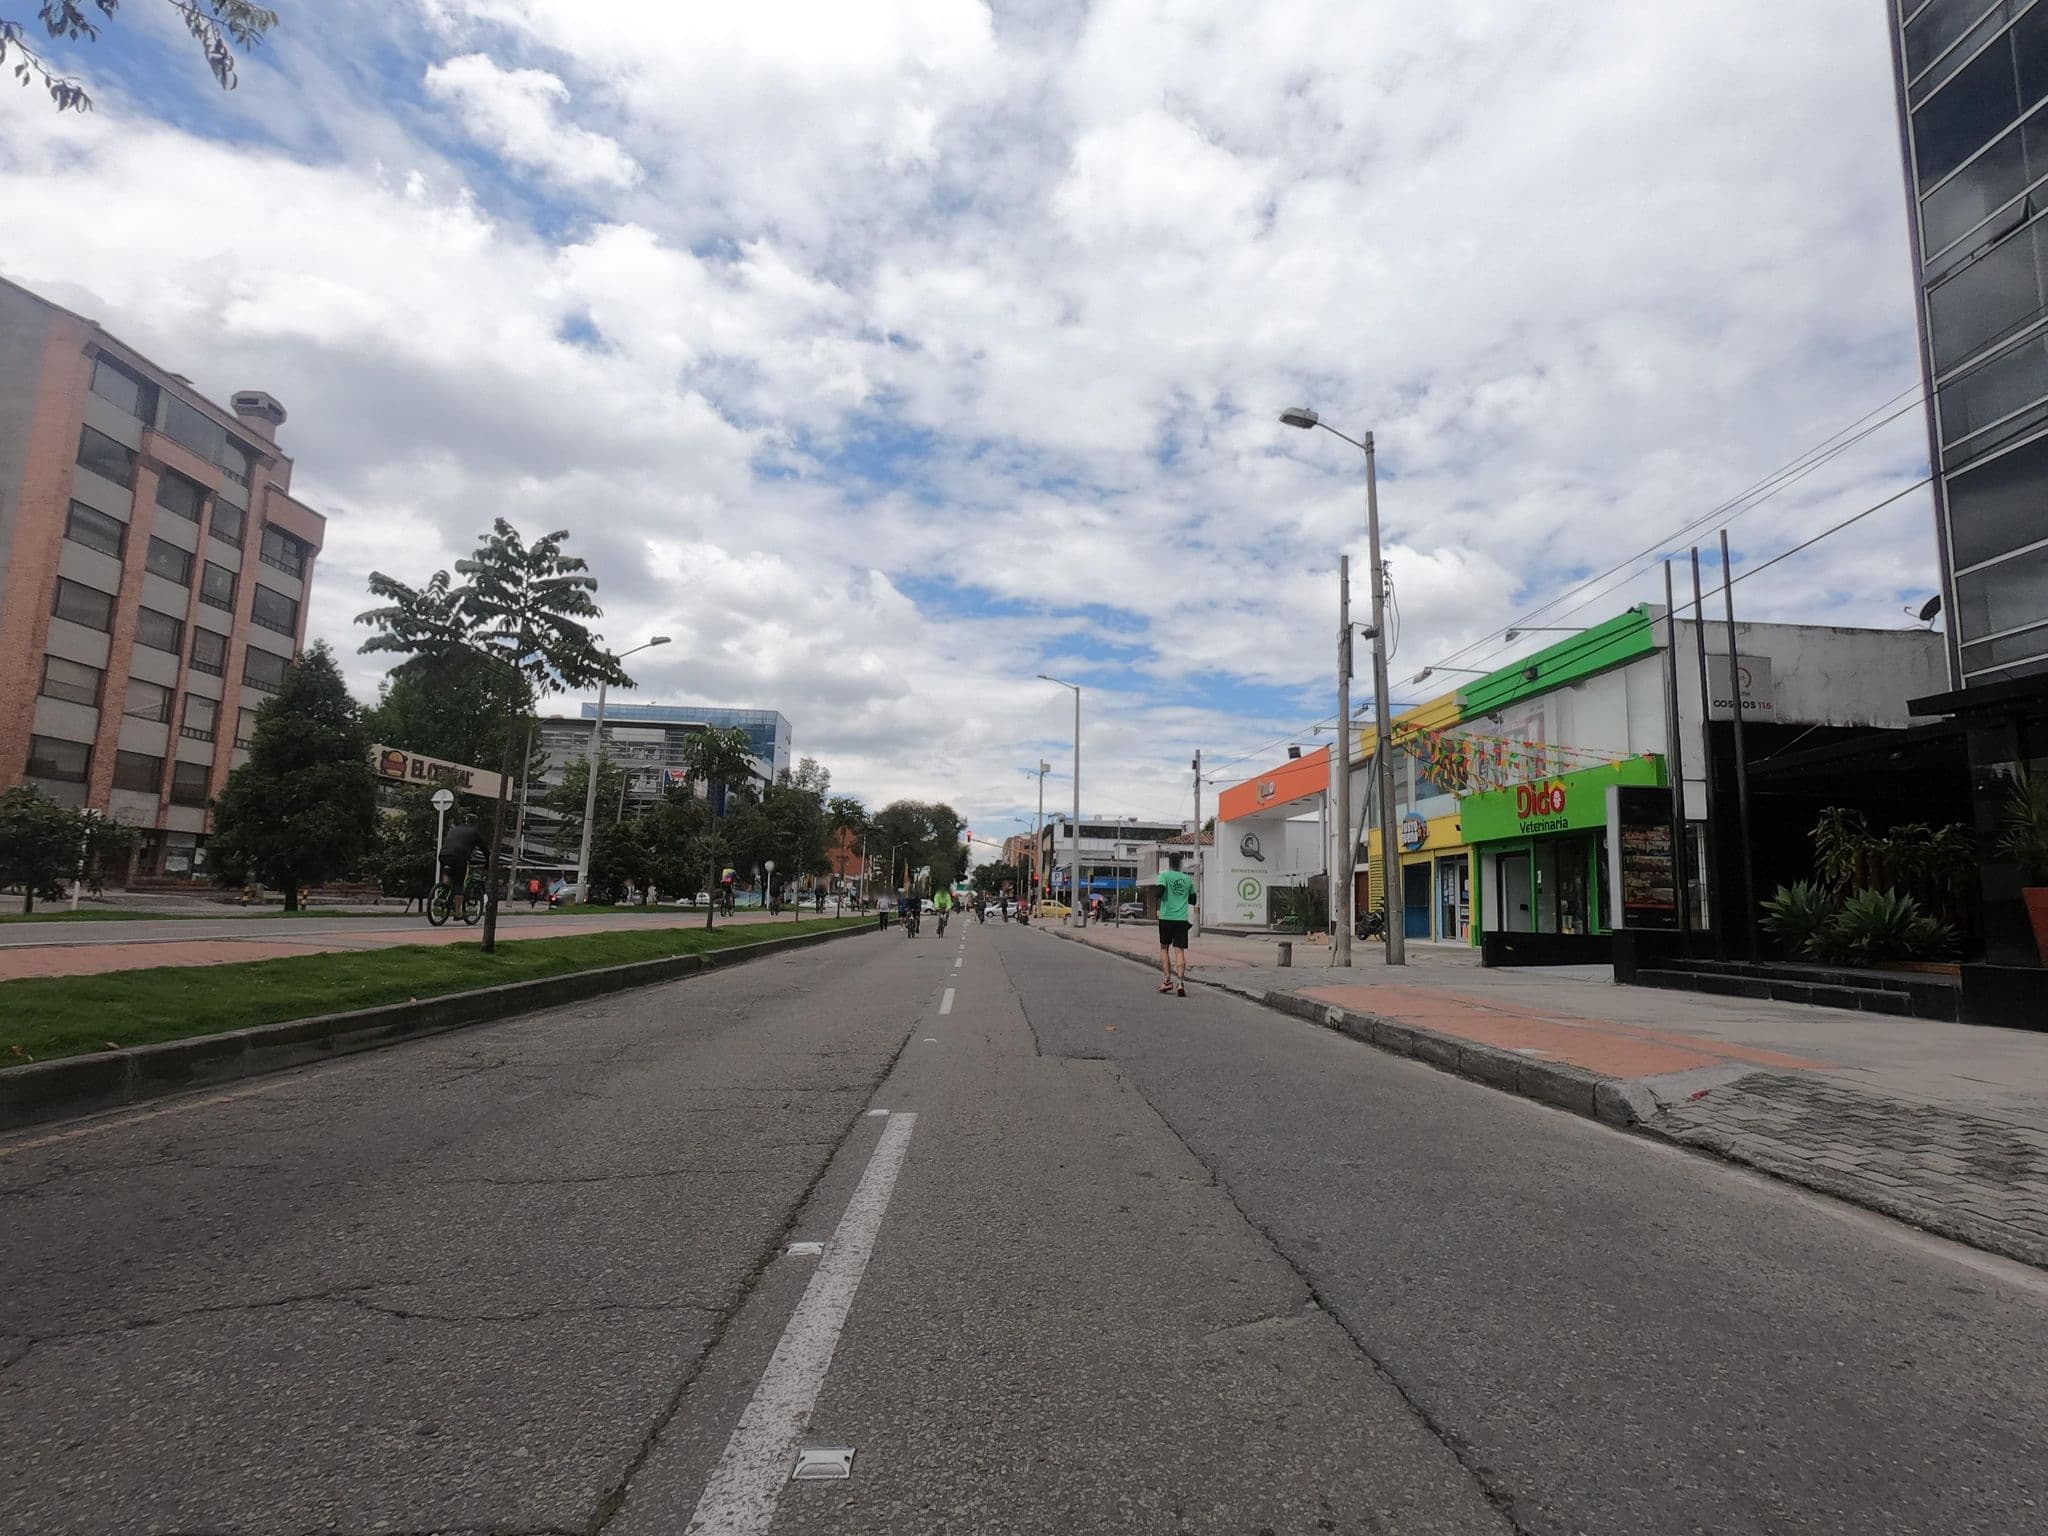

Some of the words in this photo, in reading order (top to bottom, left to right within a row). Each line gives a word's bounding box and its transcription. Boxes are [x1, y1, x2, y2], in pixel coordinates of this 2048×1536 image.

[411, 758, 427, 779] EL
[1517, 780, 1566, 819] Dido
[1519, 817, 1569, 834] Veterinaria
